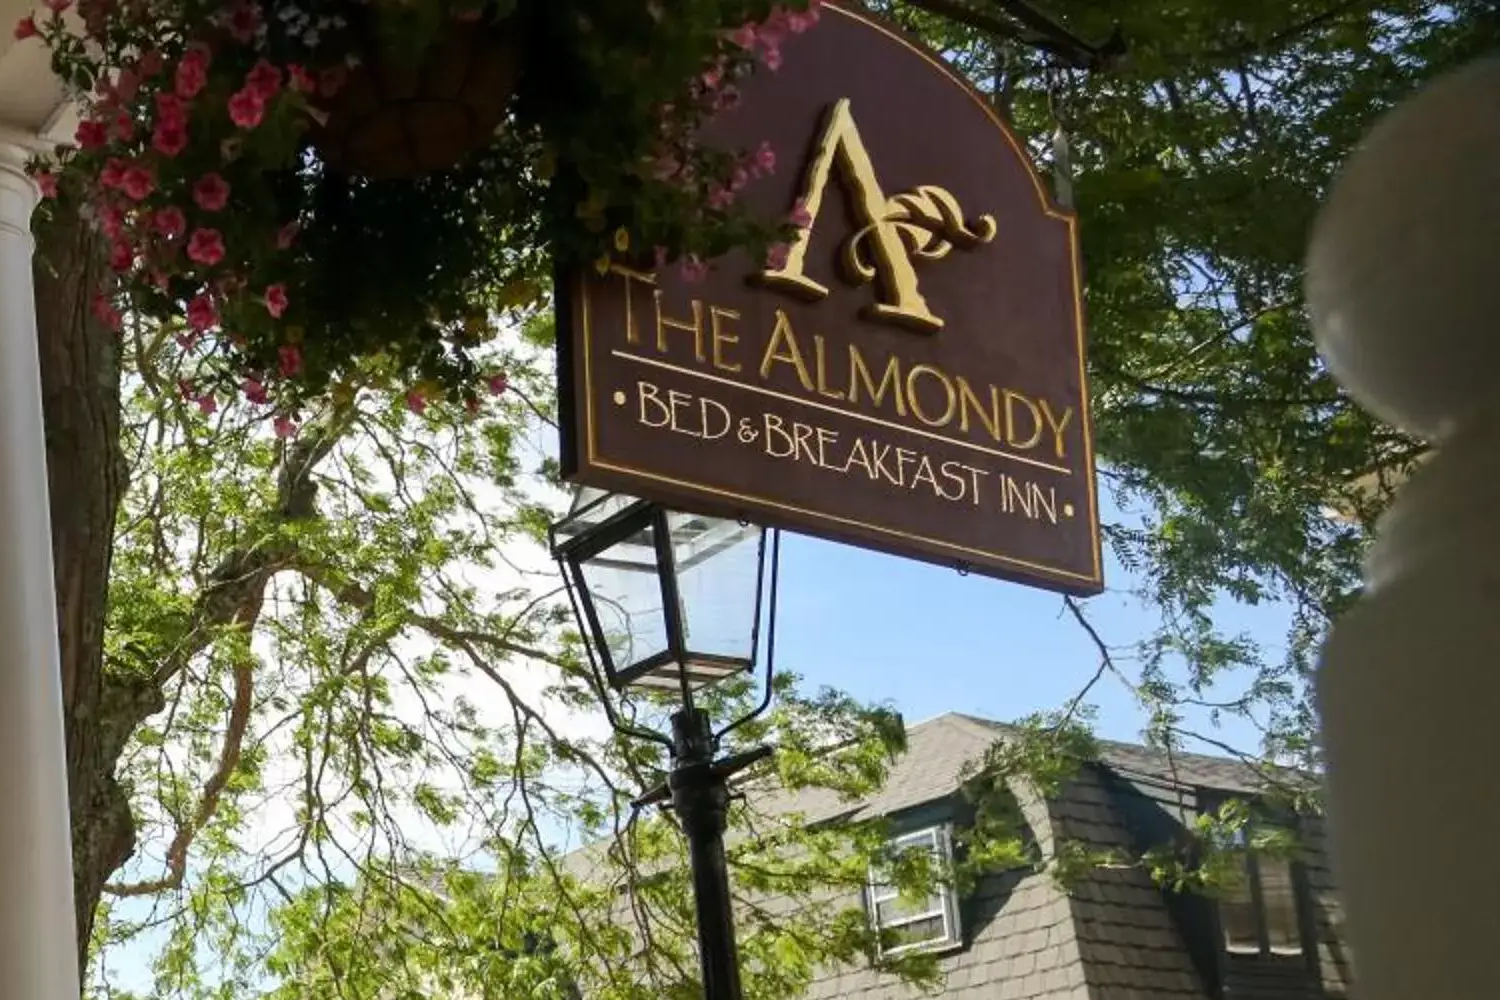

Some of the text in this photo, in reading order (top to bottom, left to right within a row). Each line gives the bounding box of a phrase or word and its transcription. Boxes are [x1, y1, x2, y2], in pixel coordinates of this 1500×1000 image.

[608, 264, 1075, 459] THE ALMONDY
[637, 381, 1058, 526] BED & BREAKFAST INN
